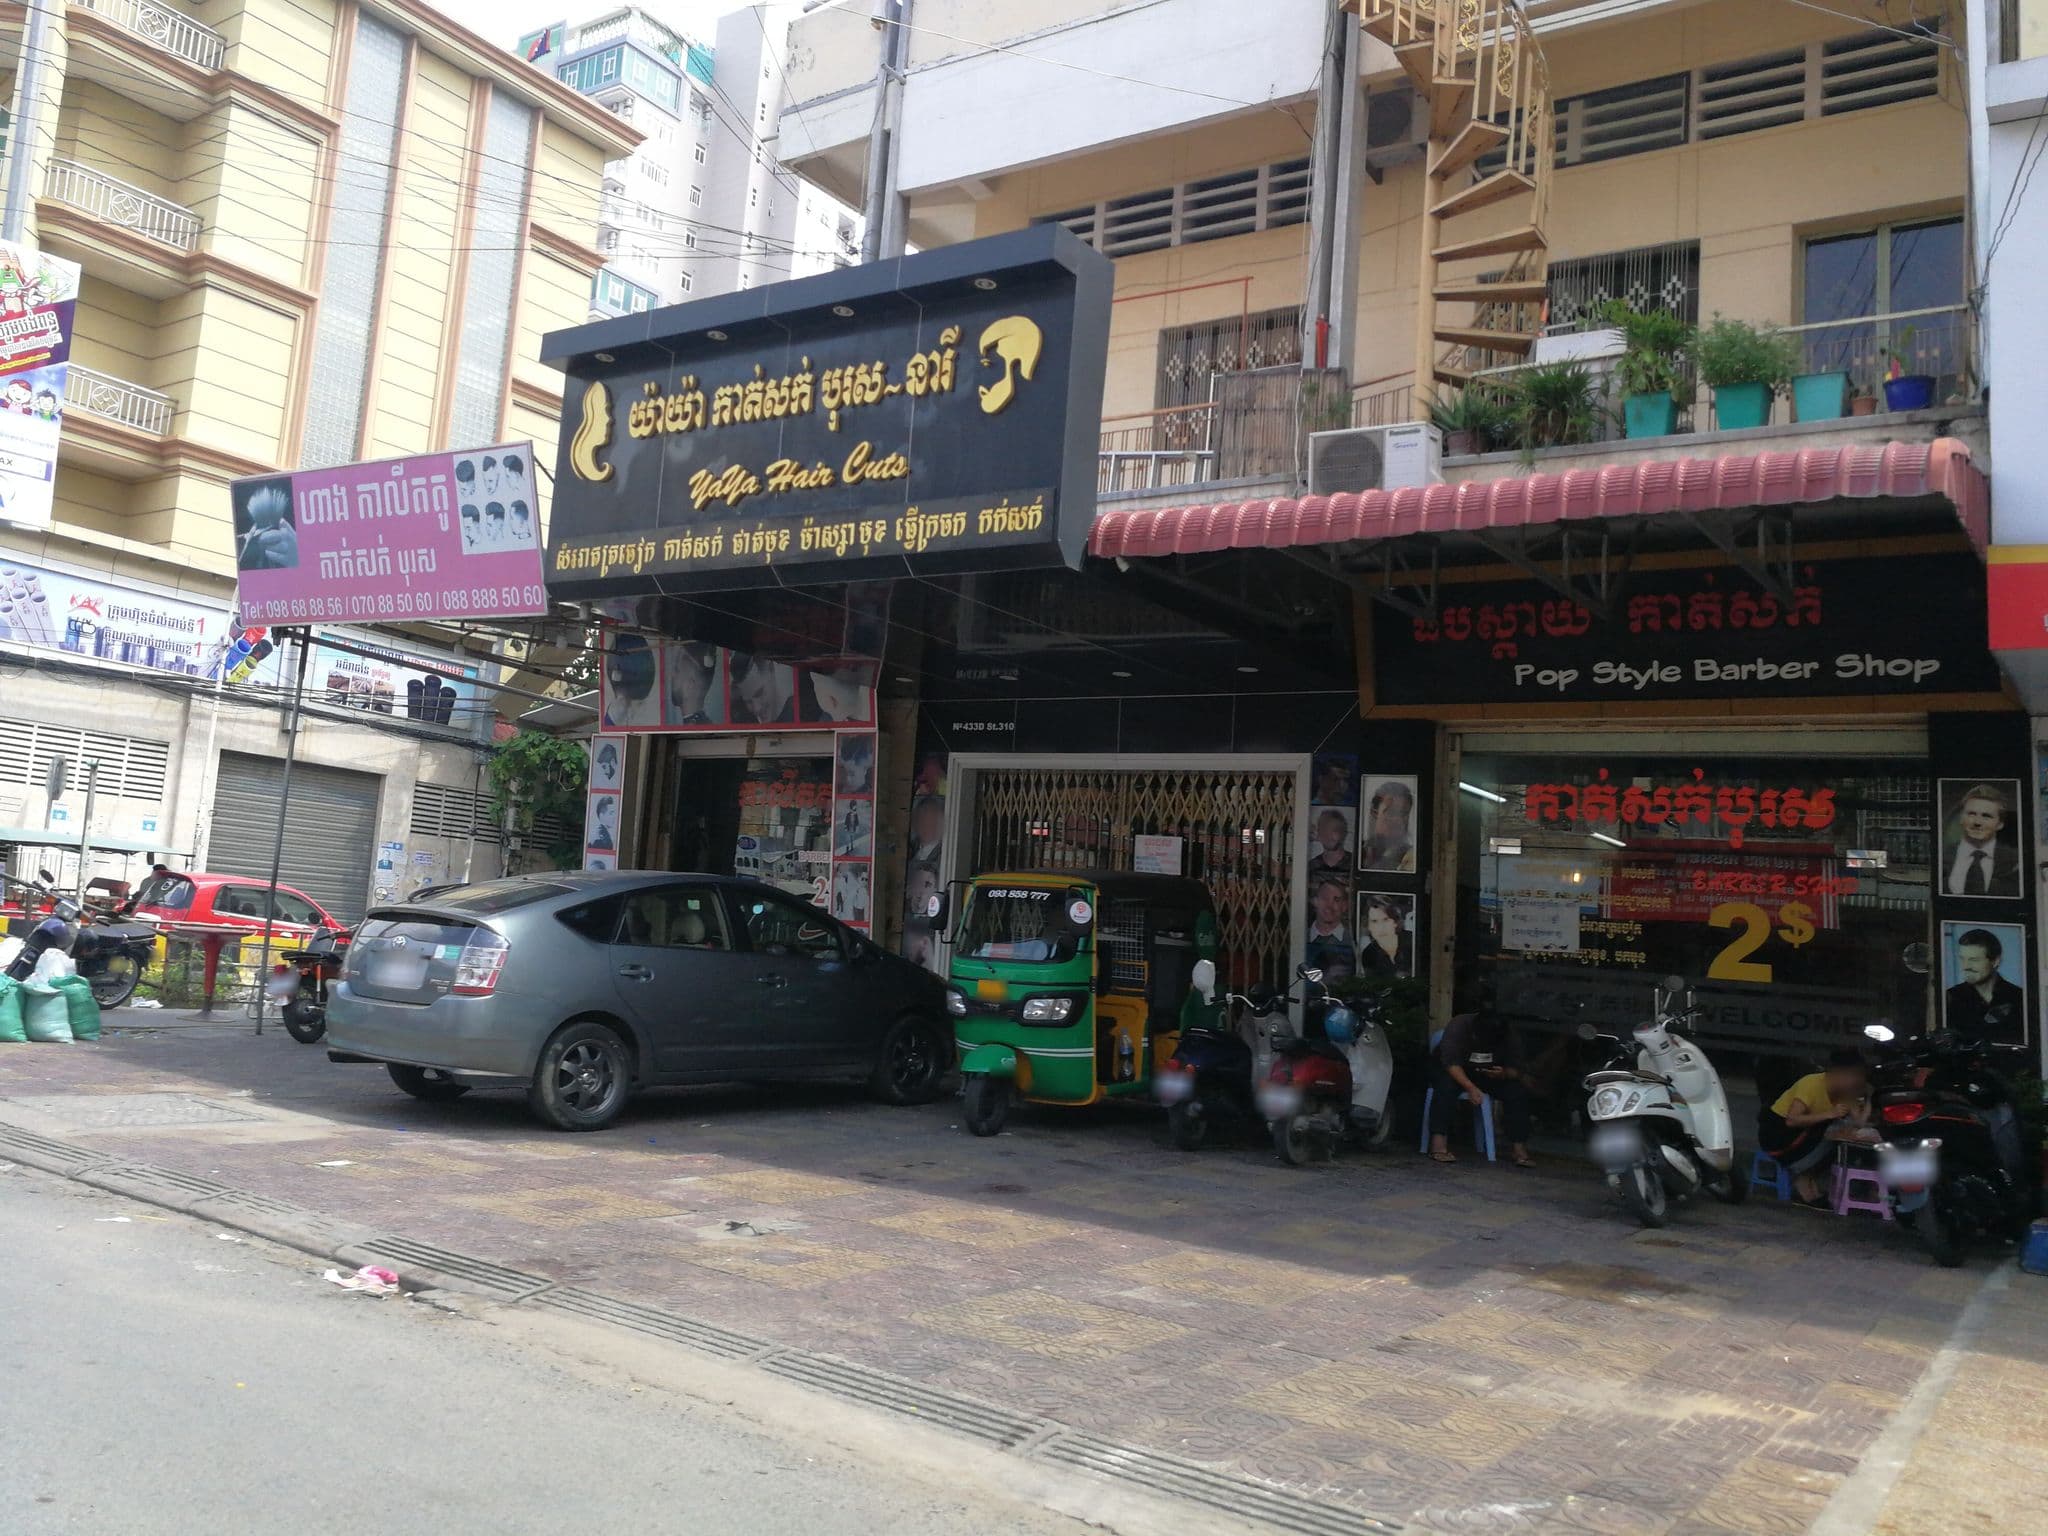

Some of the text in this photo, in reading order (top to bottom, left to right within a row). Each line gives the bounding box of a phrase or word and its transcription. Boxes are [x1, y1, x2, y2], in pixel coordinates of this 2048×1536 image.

[713, 356, 814, 427] កាត់សក់
[766, 459, 833, 492] Hair
[842, 441, 908, 484] Cuts
[299, 484, 349, 525] ហាង
[664, 527, 723, 561] កាត់សក់
[398, 547, 436, 586] បុរស
[242, 601, 264, 619] Tel:
[266, 600, 289, 618] 098
[291, 599, 307, 617] 68
[309, 598, 325, 616] 88
[327, 597, 343, 615] 56
[352, 595, 375, 614] 070
[378, 594, 393, 613] 88
[397, 593, 413, 612] 50
[416, 592, 432, 611] 60
[443, 590, 468, 610] 088
[472, 588, 498, 608] 888
[502, 587, 520, 607] 50
[524, 585, 542, 606] 60
[1514, 653, 1941, 692] Pop Style Barber Shop
[1030, 891, 1051, 901] 777
